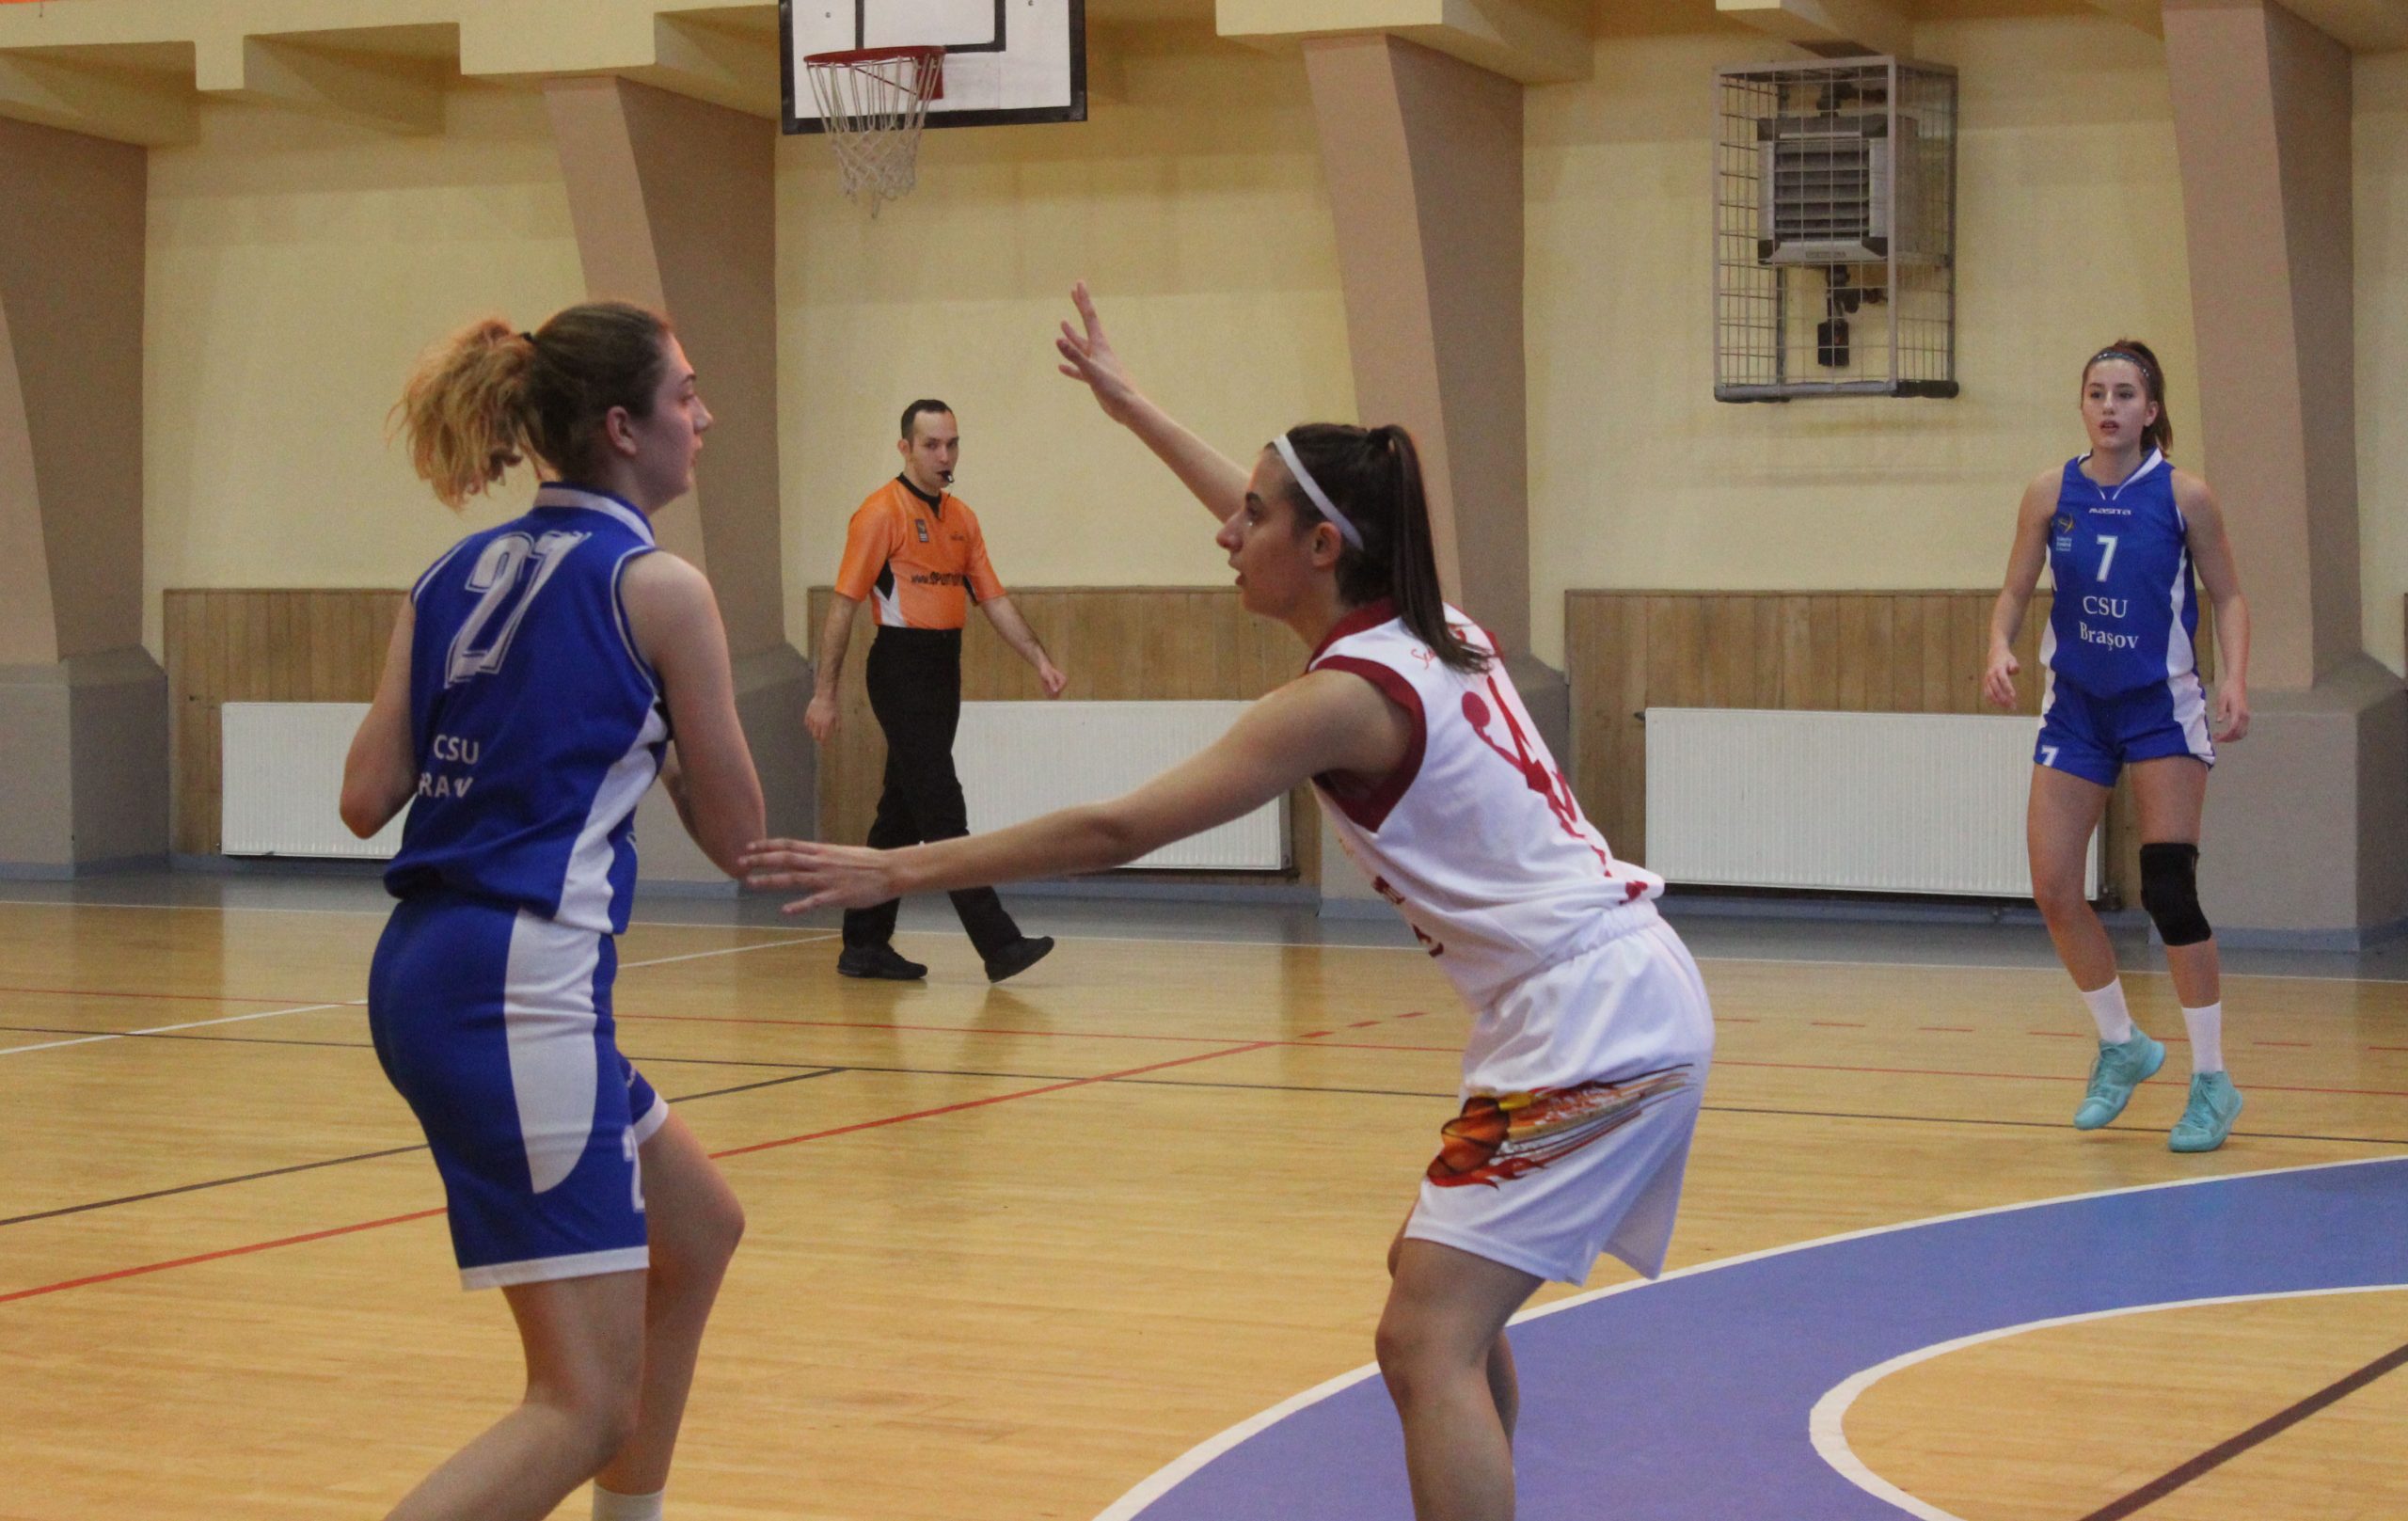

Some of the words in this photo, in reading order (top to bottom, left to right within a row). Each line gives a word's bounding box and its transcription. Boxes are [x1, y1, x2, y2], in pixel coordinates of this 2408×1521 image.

[2097, 534, 2117, 582] 7
[2083, 595, 2128, 618] CSU
[434, 735, 479, 765] CSU
[2041, 745, 2060, 768] 7
